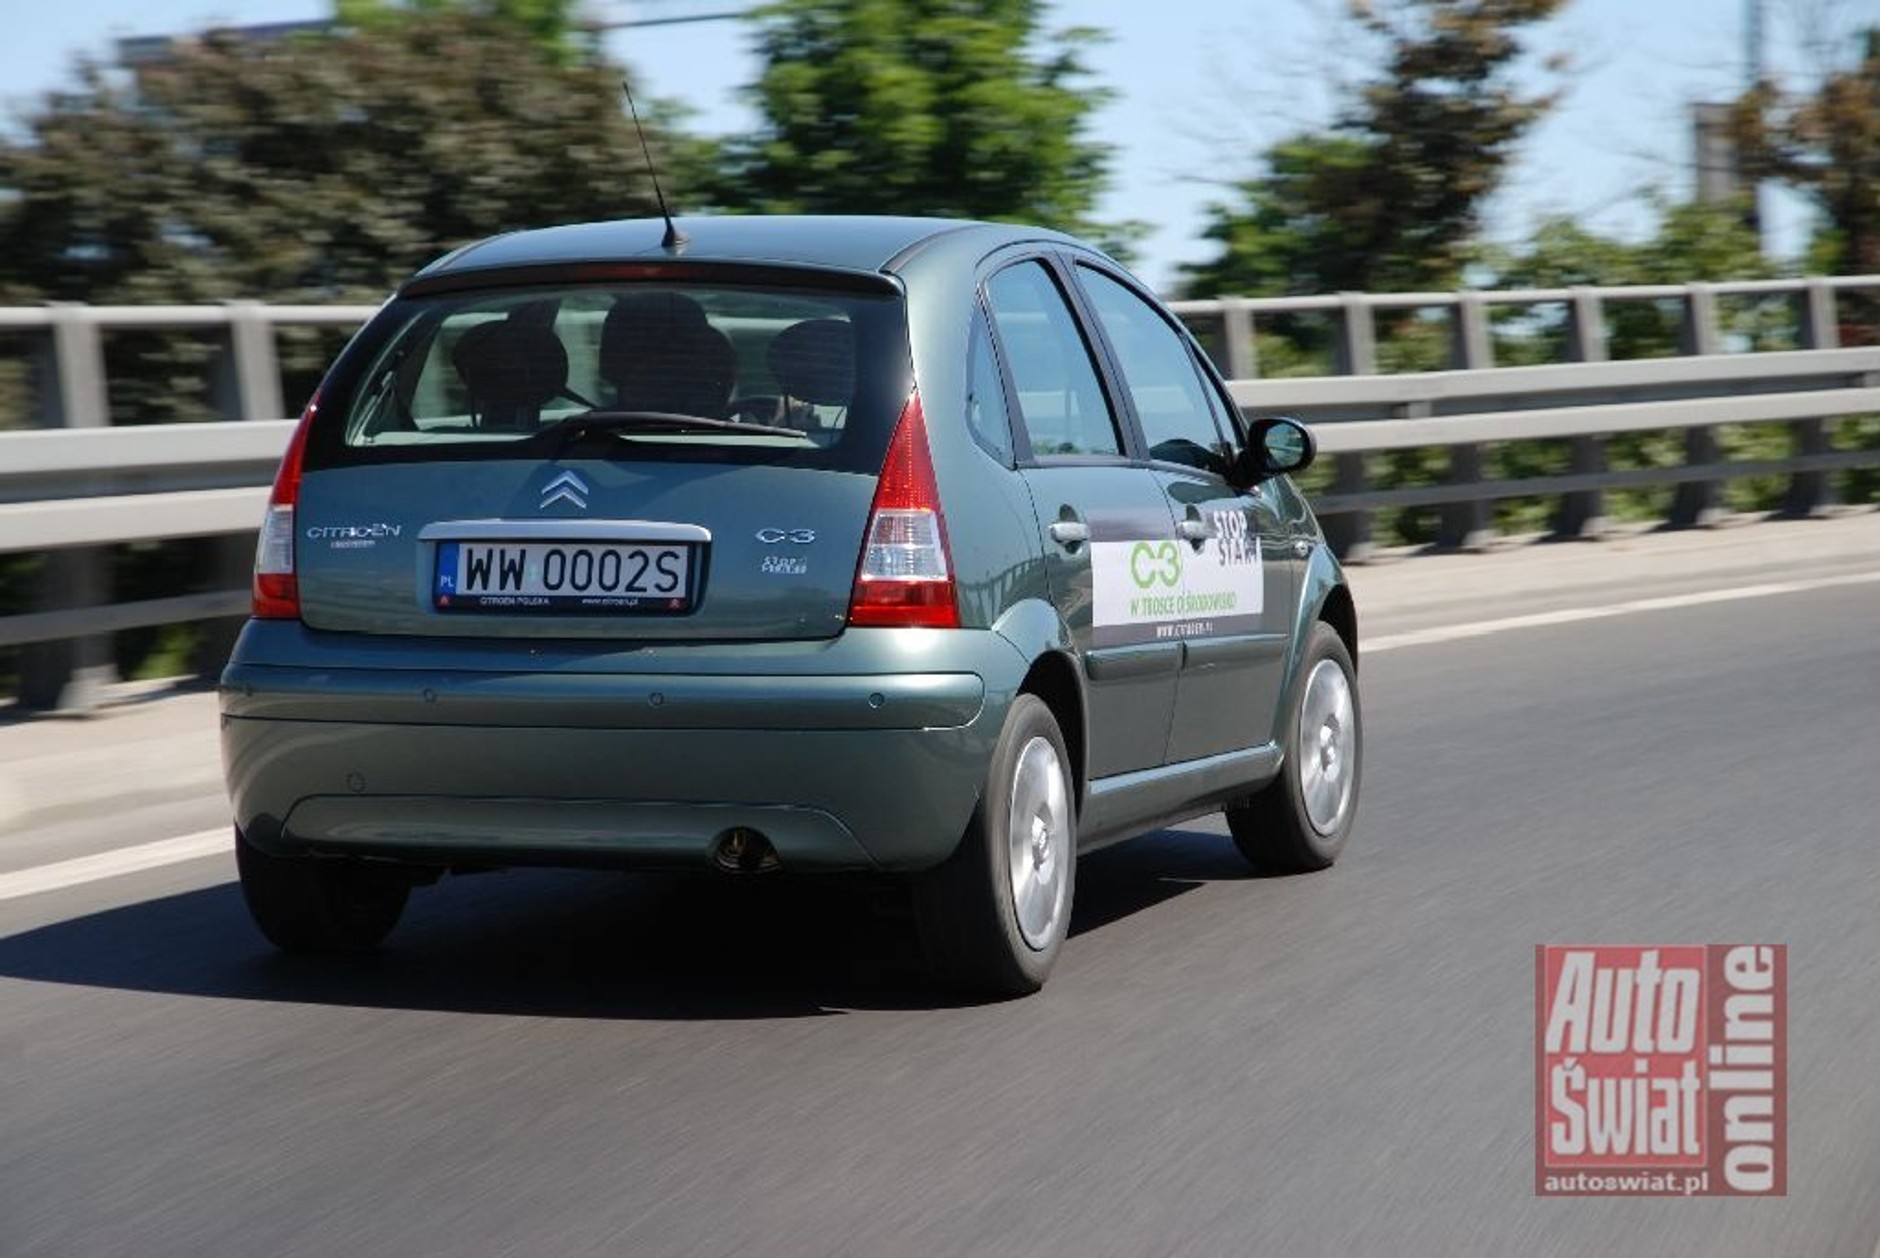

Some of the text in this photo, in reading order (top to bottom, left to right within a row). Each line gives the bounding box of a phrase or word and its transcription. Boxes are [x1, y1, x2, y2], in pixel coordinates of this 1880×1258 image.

[755, 527, 815, 544] C3
[1213, 510, 1247, 539] STOP
[465, 548, 680, 593] WW 0002S
[1131, 541, 1180, 589] C3
[440, 575, 455, 588] PL
